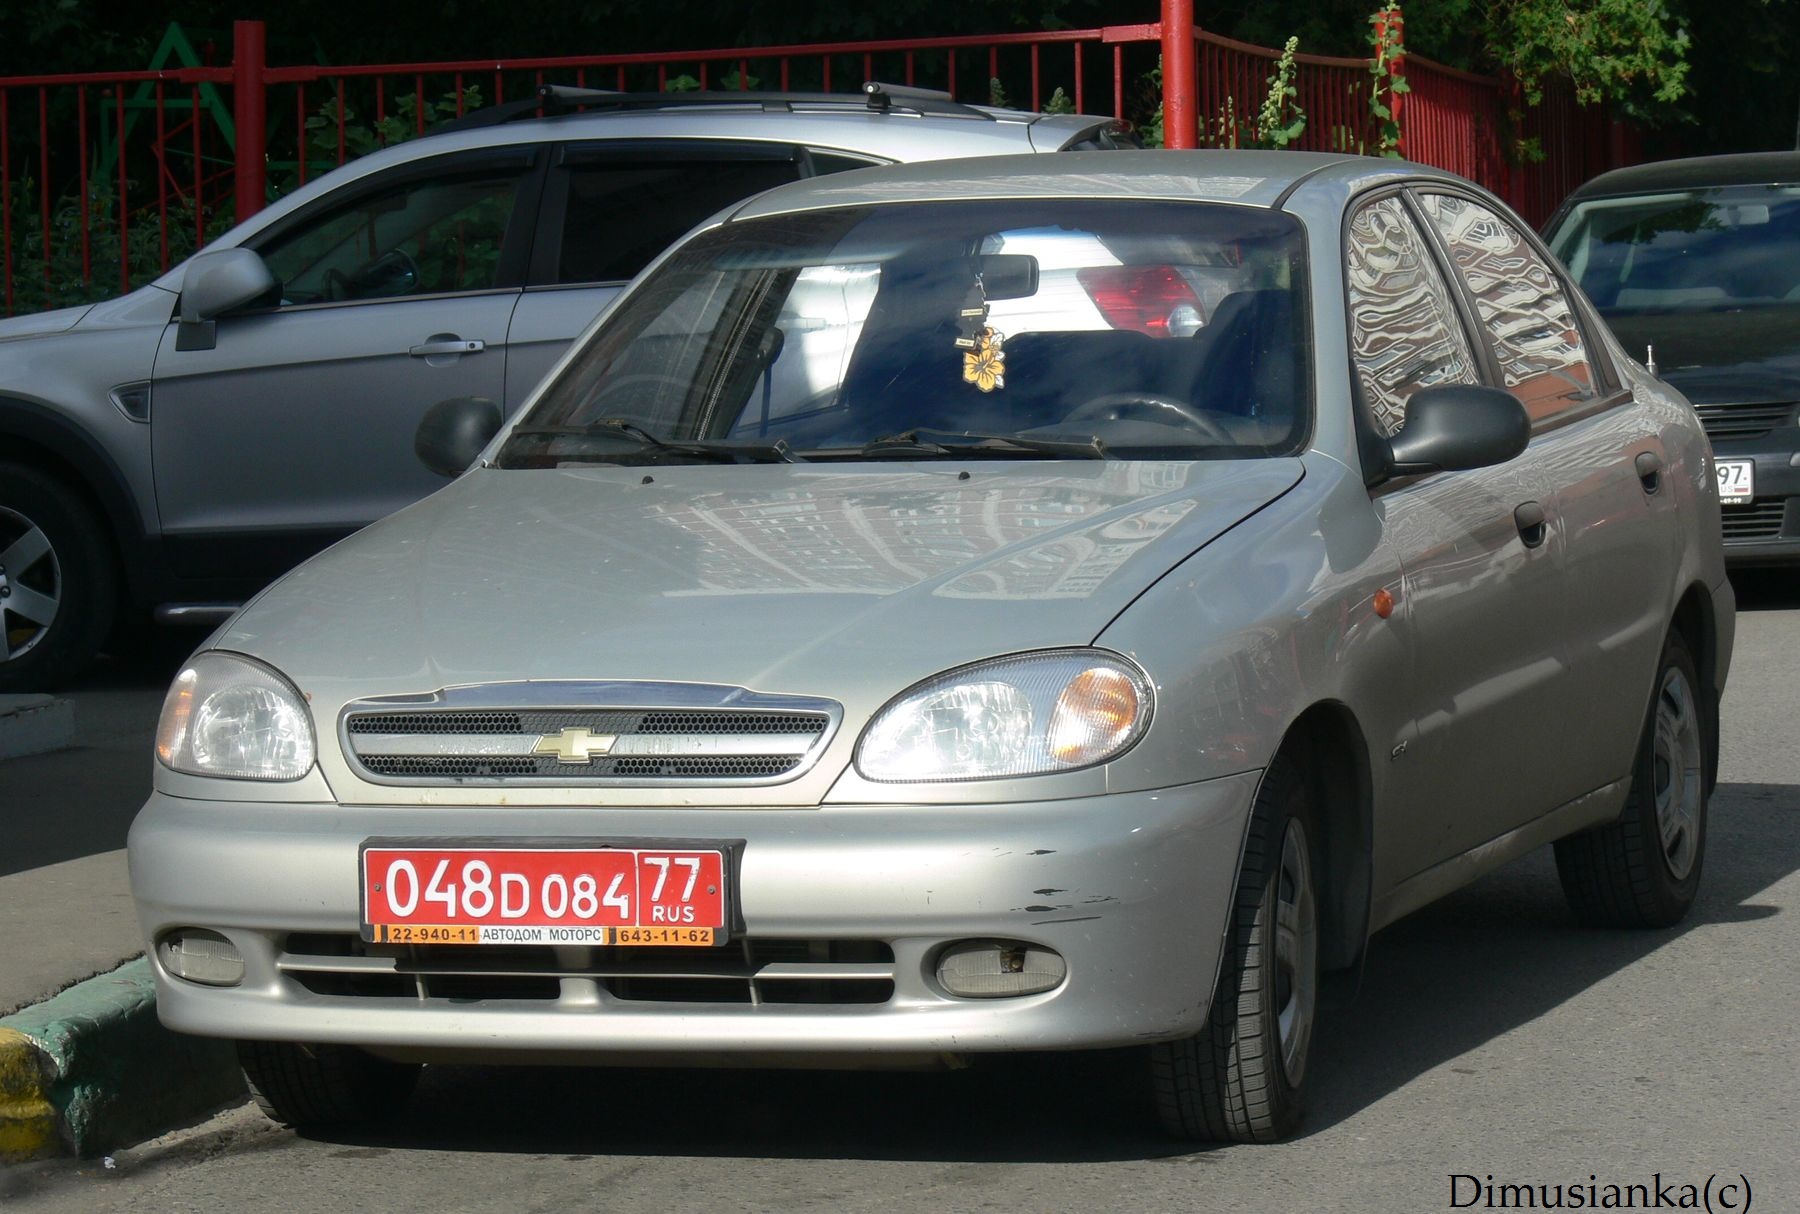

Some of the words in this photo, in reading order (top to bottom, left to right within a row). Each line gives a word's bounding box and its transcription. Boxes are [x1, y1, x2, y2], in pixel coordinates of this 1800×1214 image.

[1717, 465, 1743, 485] 97
[643, 857, 701, 903] 77
[652, 905, 696, 923] RUS
[392, 928, 477, 941] 22-940-11
[482, 928, 542, 942] АВТОДОМ
[549, 929, 601, 941] МОТОРС
[620, 930, 710, 942] 643-11-62
